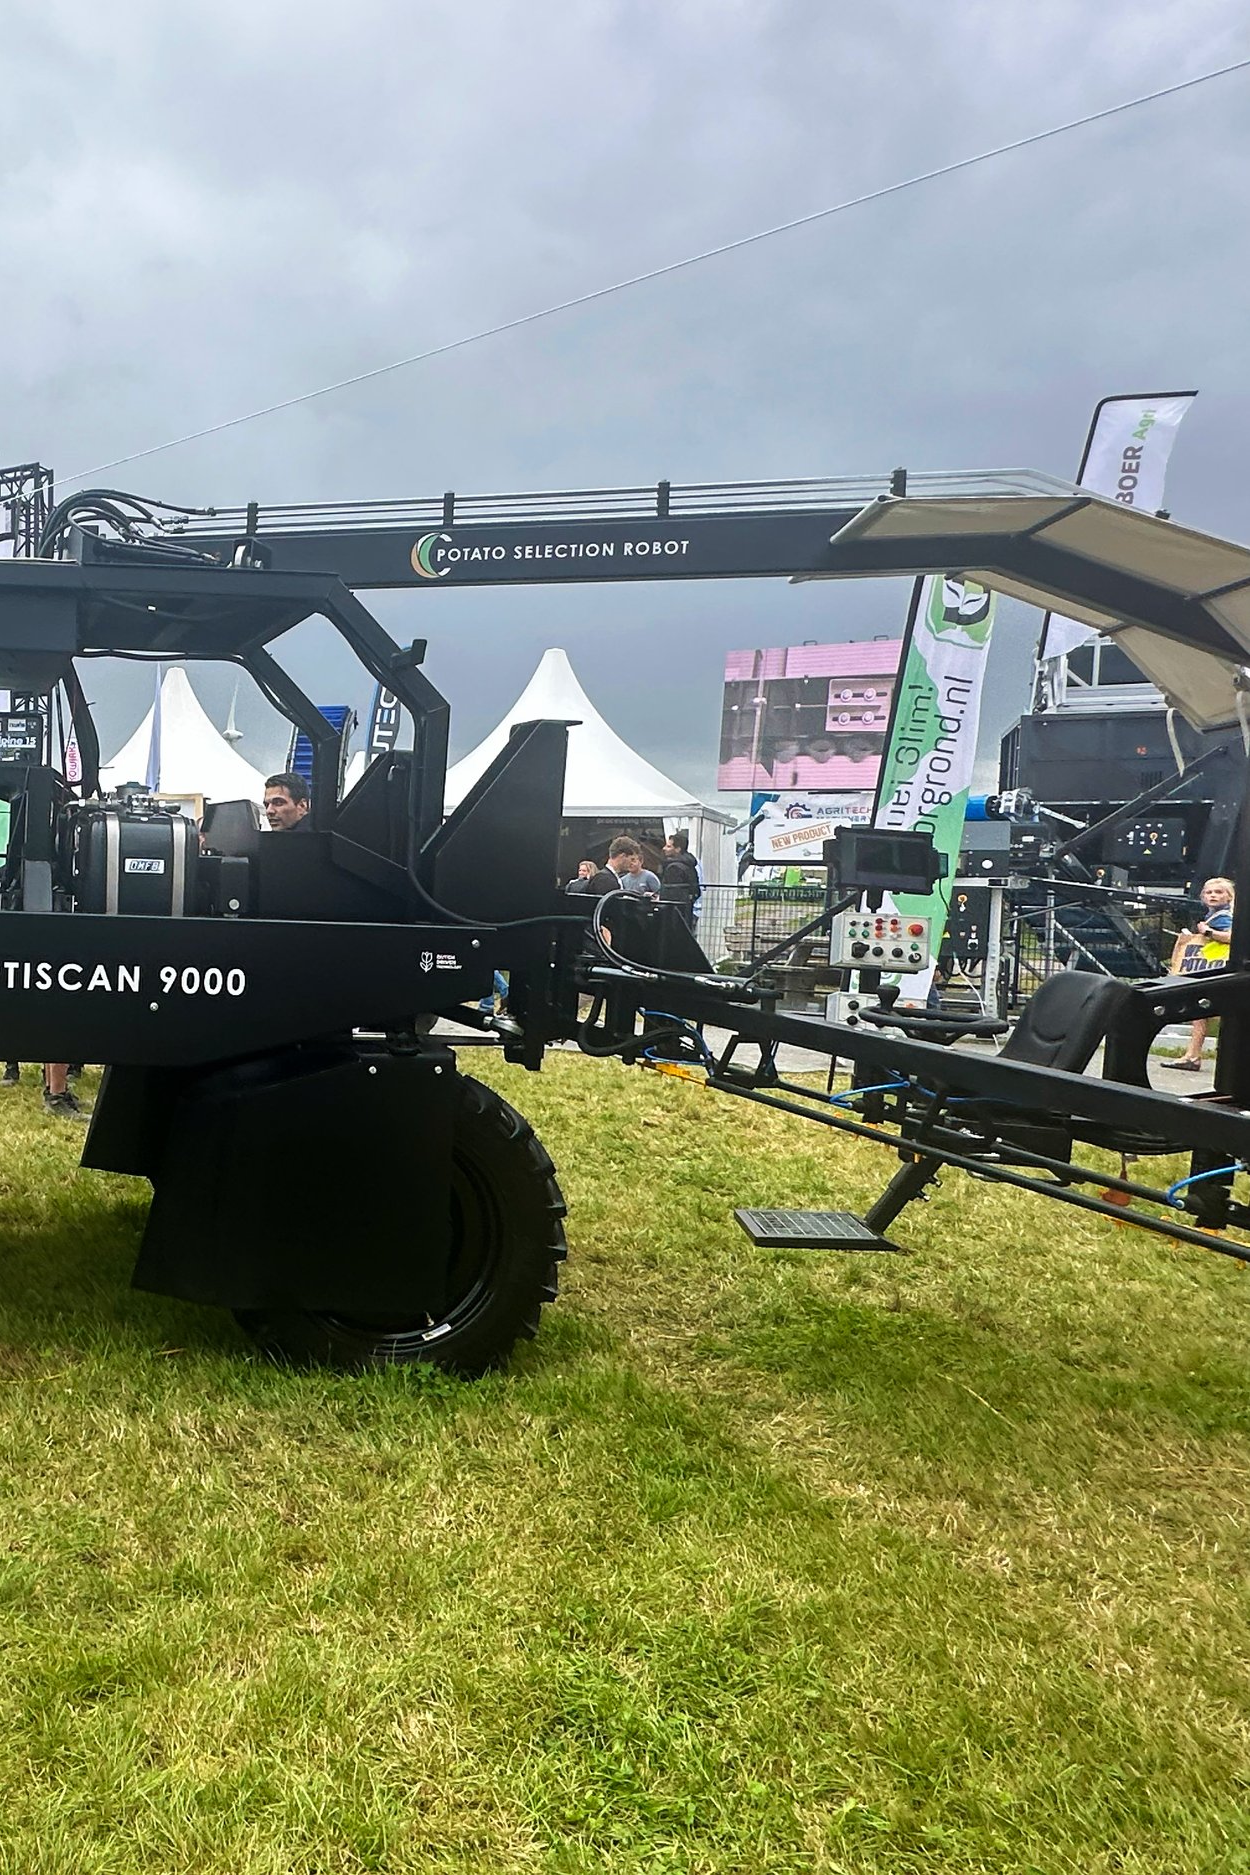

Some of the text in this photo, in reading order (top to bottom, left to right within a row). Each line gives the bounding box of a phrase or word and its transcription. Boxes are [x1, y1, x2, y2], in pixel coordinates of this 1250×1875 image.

[1132, 410, 1157, 440] Agri
[437, 540, 690, 562] POTATO SELECTION ROBOT
[25, 736, 37, 746] 15
[770, 824, 831, 849] NEW PRODUCT
[159, 966, 247, 996] 9000
